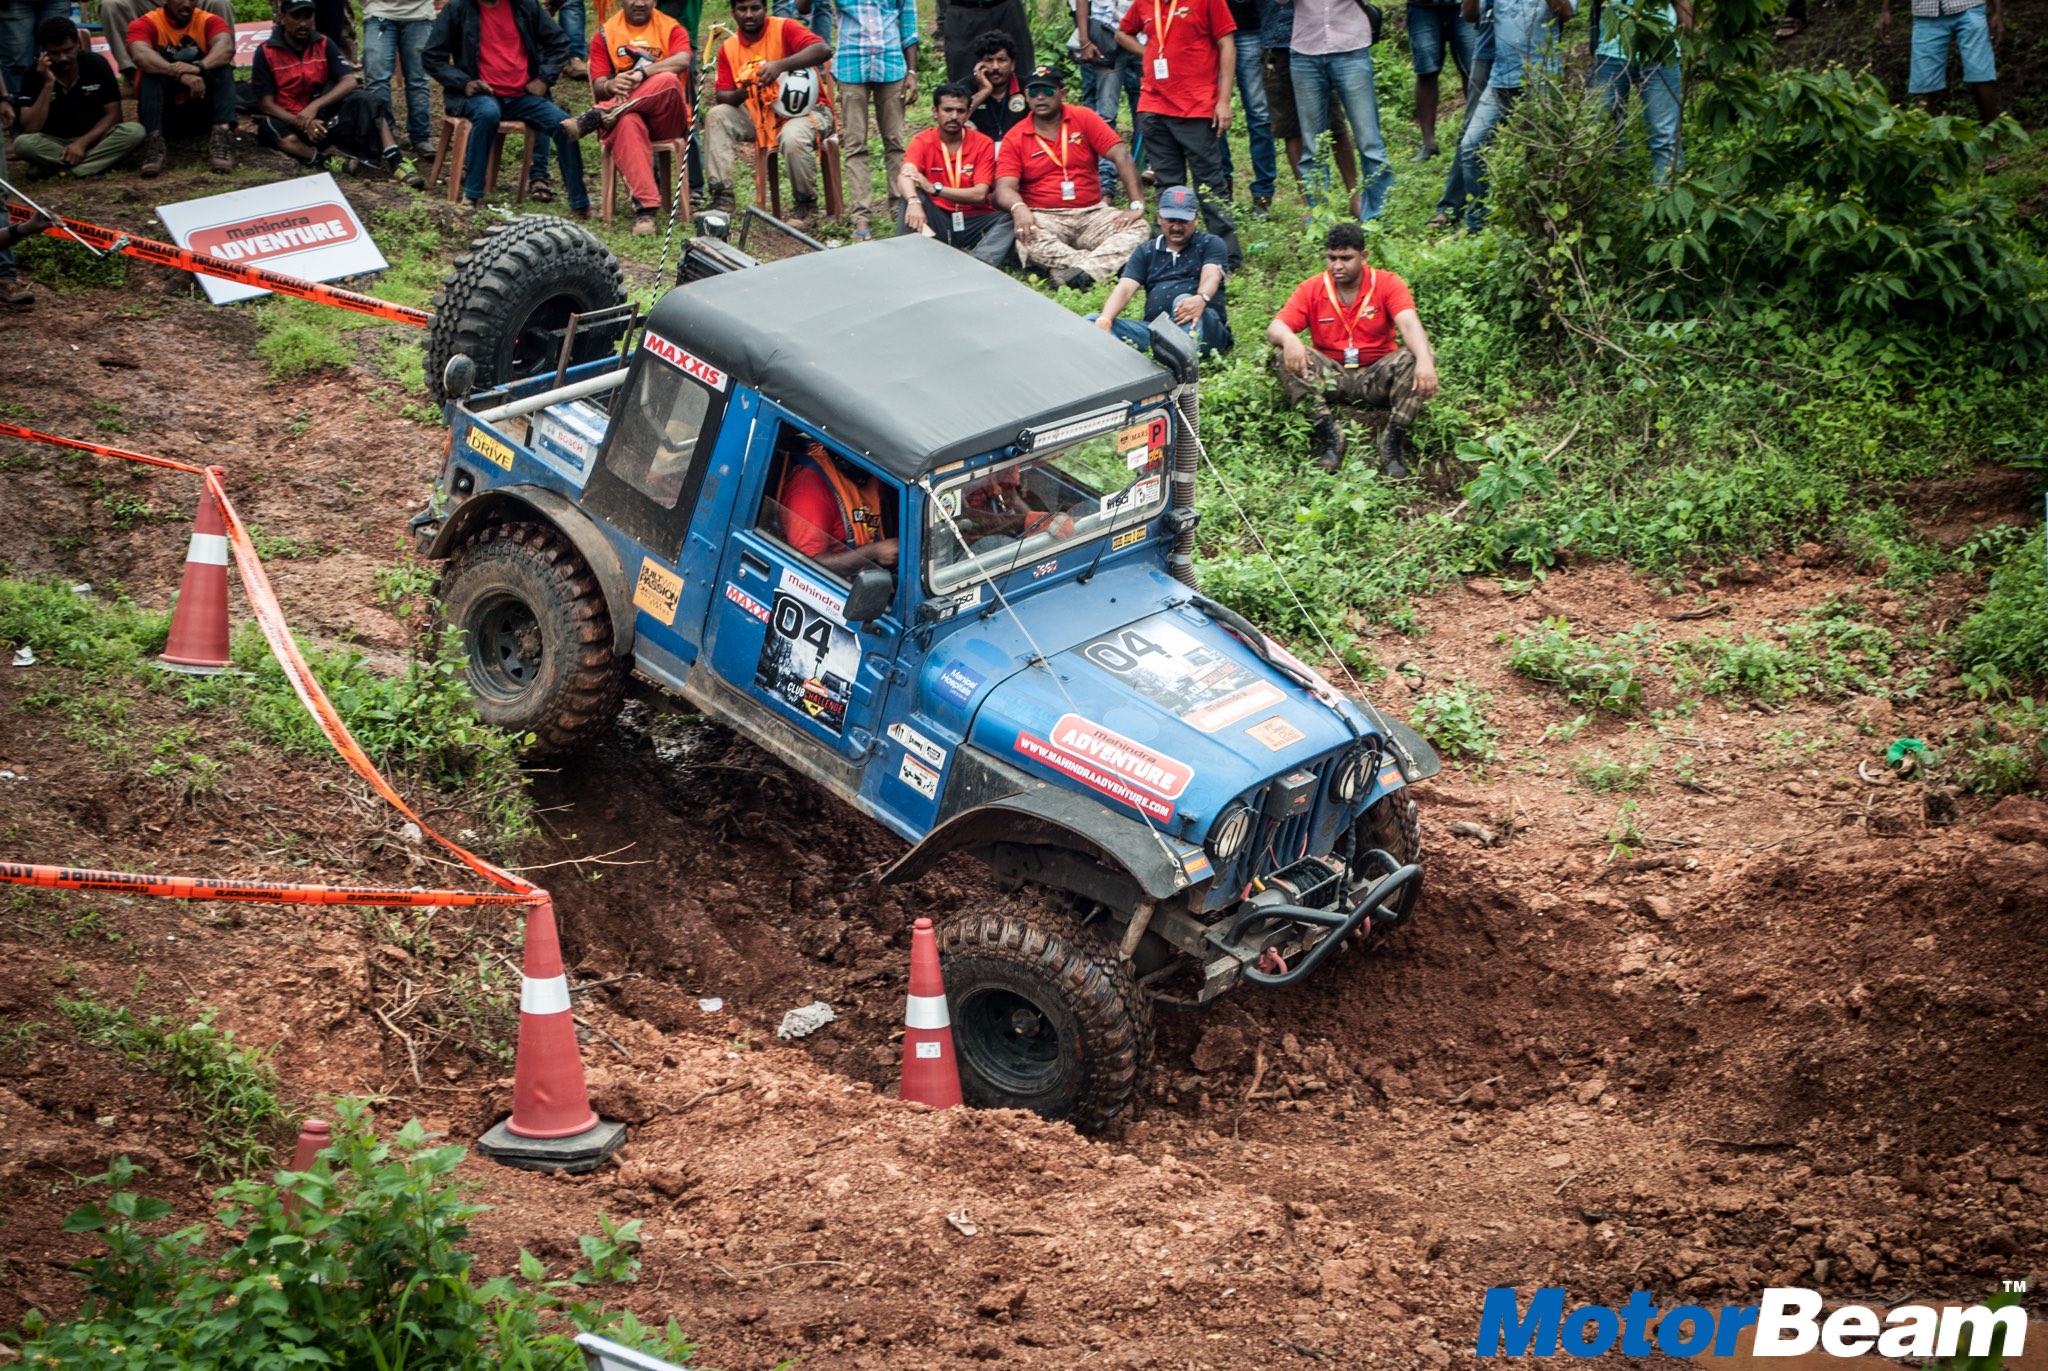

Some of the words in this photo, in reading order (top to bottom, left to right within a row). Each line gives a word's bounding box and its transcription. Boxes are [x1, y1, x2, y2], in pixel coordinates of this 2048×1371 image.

[208, 218, 349, 261] ADVENTURE
[645, 334, 721, 385] MAXXIS
[471, 435, 511, 470] DRIVE
[557, 431, 584, 454] BOSCH
[1152, 423, 1162, 443] P
[639, 572, 679, 604] PASSION
[726, 586, 770, 624] MAXXI
[774, 596, 835, 661] 04
[1084, 628, 1168, 675] 04
[787, 681, 806, 698] CLUB
[1019, 737, 1170, 818] WWW.MAHINDRAADVENTURE.COM
[1060, 729, 1178, 791] ADVENTURE
